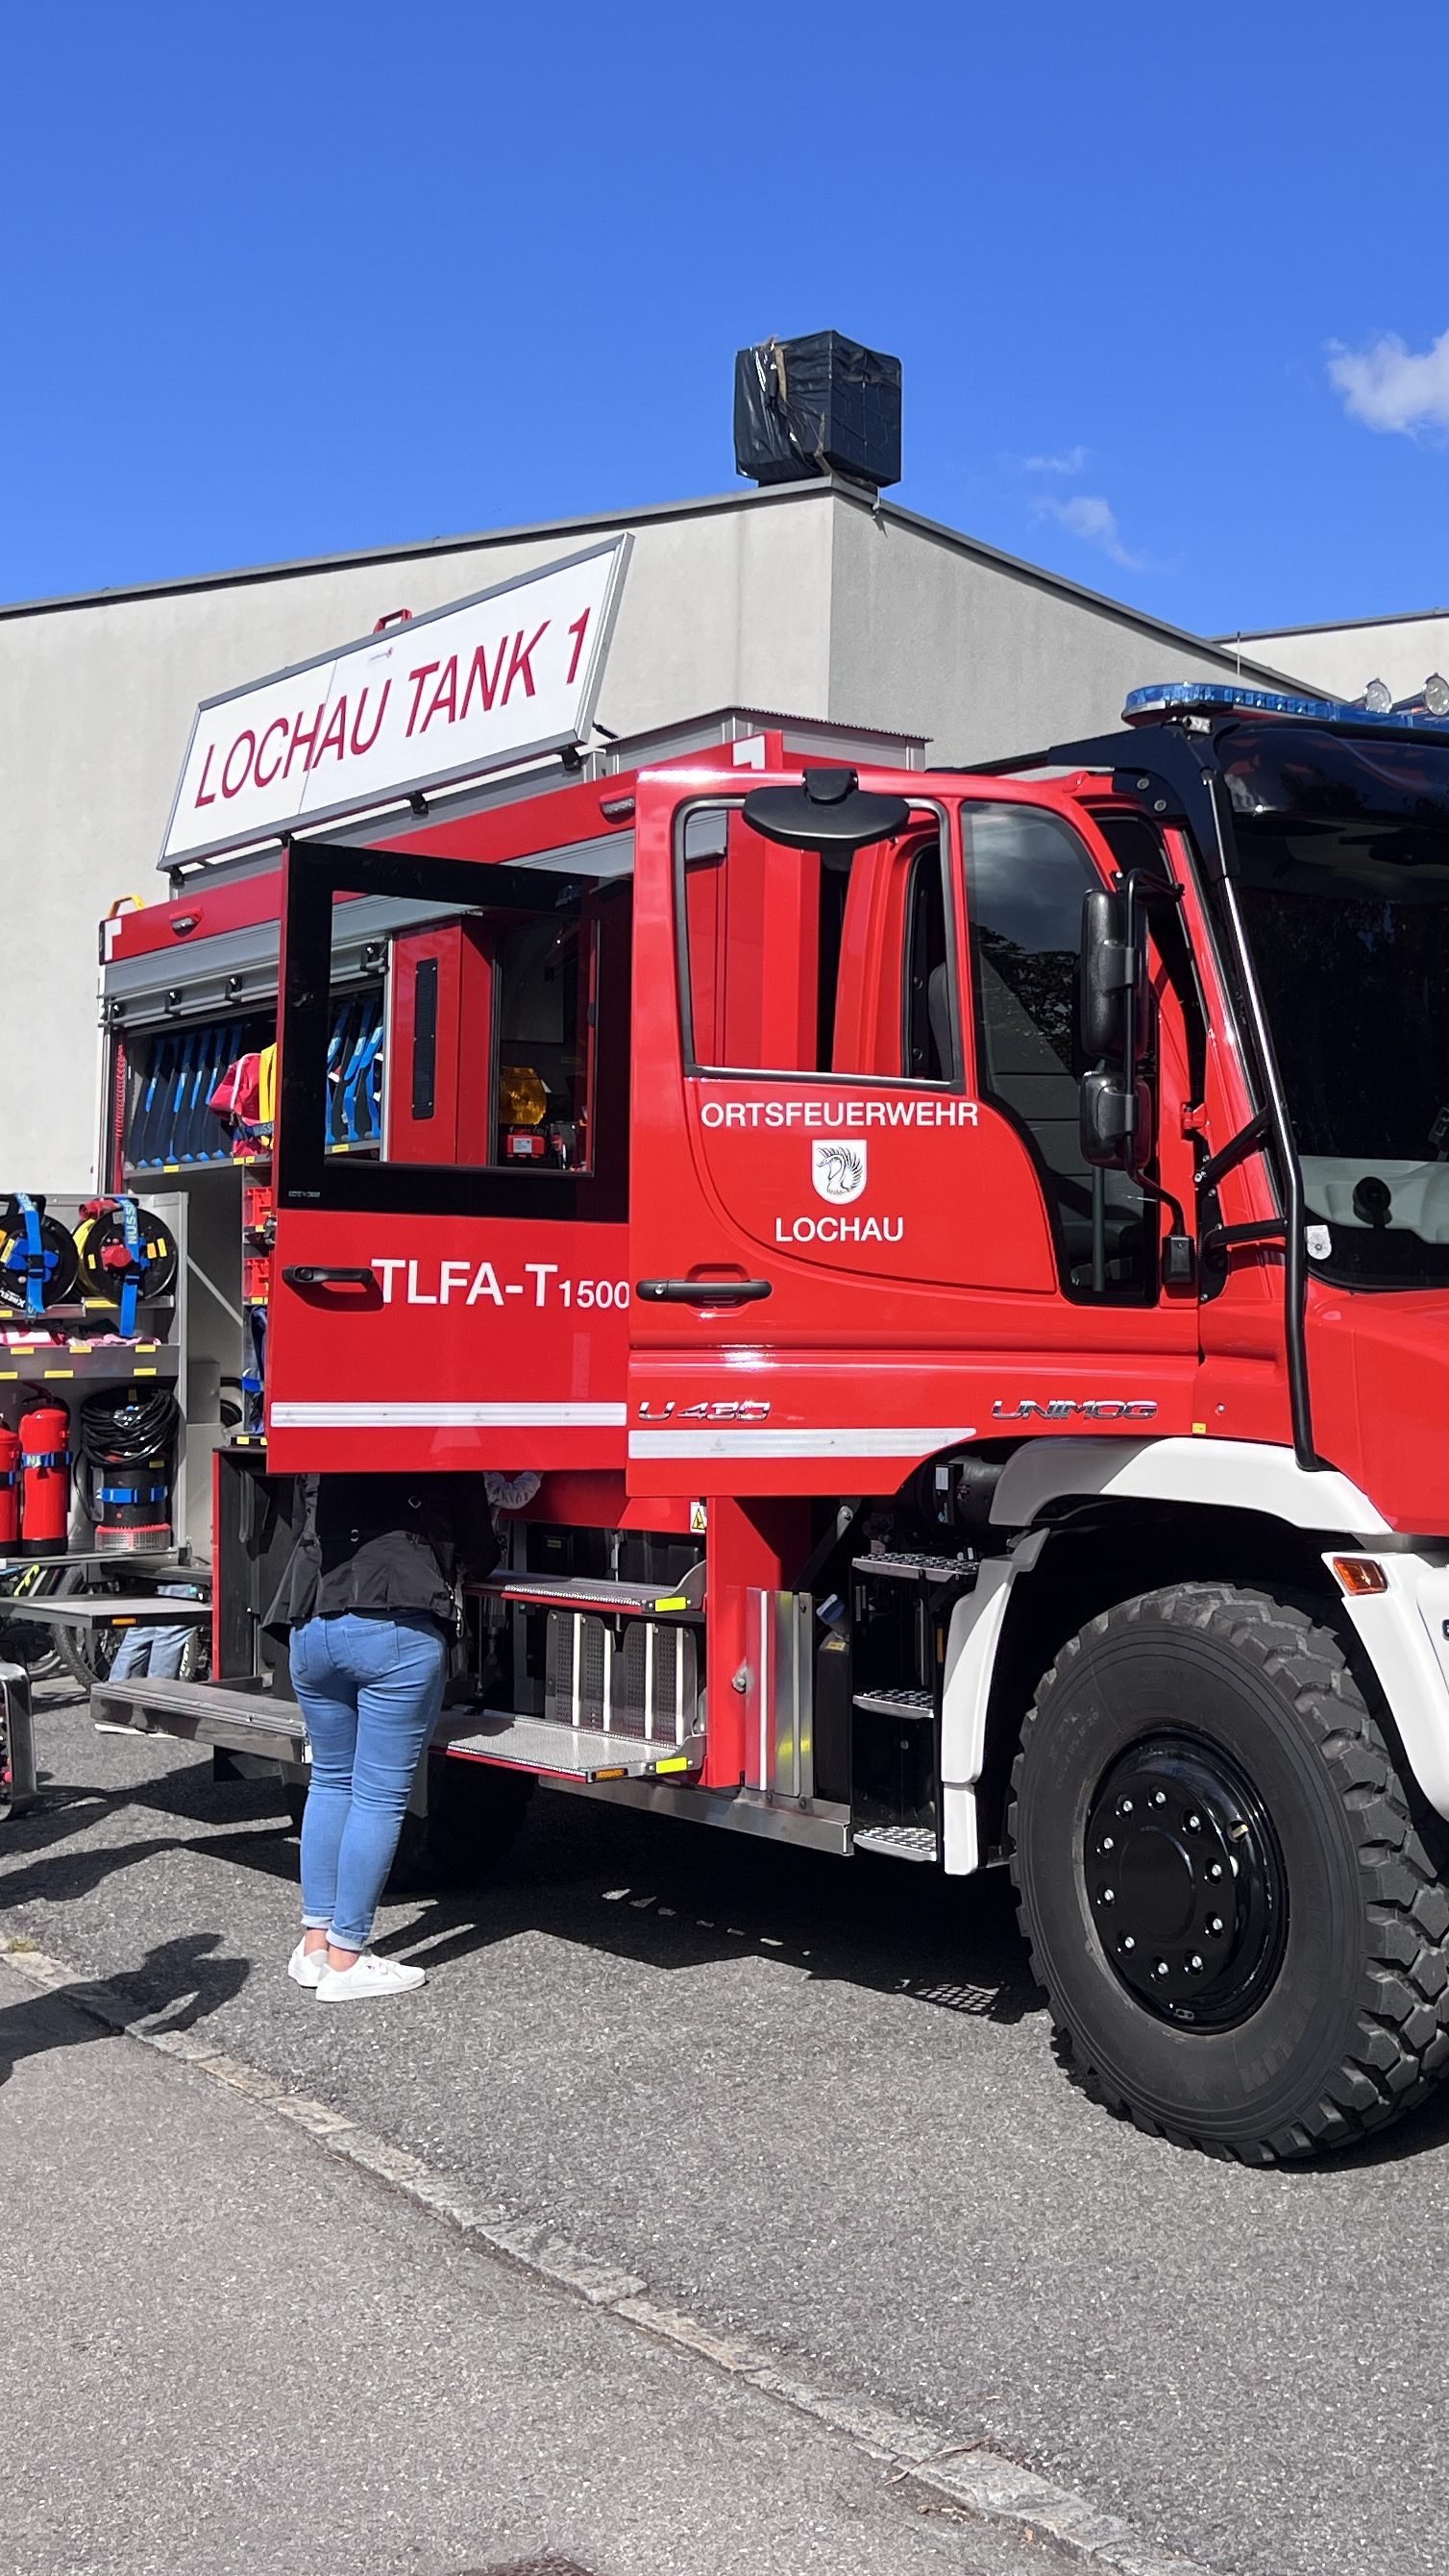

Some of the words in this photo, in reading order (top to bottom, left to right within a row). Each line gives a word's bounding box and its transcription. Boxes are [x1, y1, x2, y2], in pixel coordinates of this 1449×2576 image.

[194, 678, 392, 809] LOCHAU
[405, 620, 552, 738] TANK
[566, 607, 592, 685] 1
[700, 1101, 978, 1127] ORTSFEUERWEHR
[775, 1216, 904, 1242] LOCHAU
[371, 1258, 558, 1307] TLFA-T
[558, 1280, 630, 1310] 1500
[638, 1401, 675, 1420] U
[676, 1400, 771, 1420] 430
[992, 1399, 1158, 1420] UNIMOG
